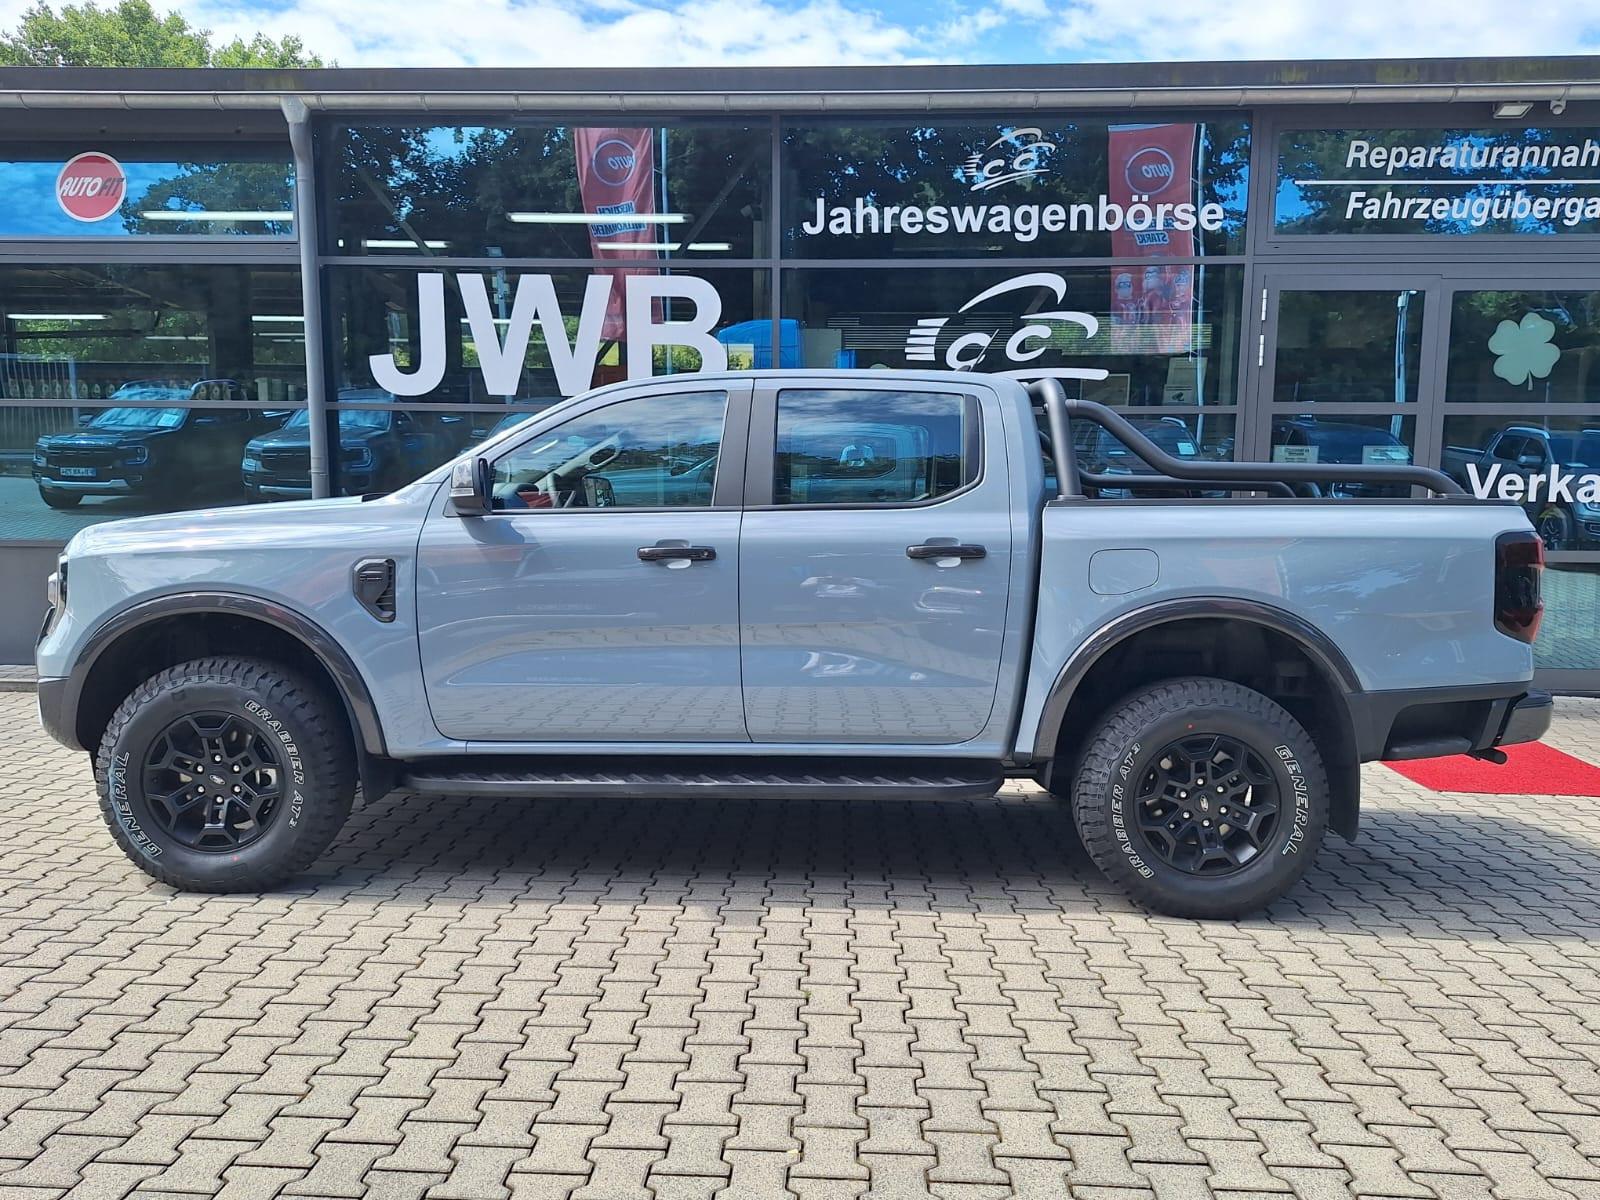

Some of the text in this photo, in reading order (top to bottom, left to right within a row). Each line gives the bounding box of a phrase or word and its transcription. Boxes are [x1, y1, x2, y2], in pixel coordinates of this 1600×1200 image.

[1346, 139, 1600, 175] Reparaturannah
[802, 194, 1225, 242] Jahreswagenbörse
[1345, 190, 1600, 227] Fahrzeugüberga
[368, 272, 728, 397] JWB
[1466, 463, 1600, 503] Verka
[244, 699, 305, 785] GRABBER
[114, 751, 163, 859] GENERAL
[1111, 784, 1154, 879] GRABBER
[1274, 744, 1309, 856] GENERAL
